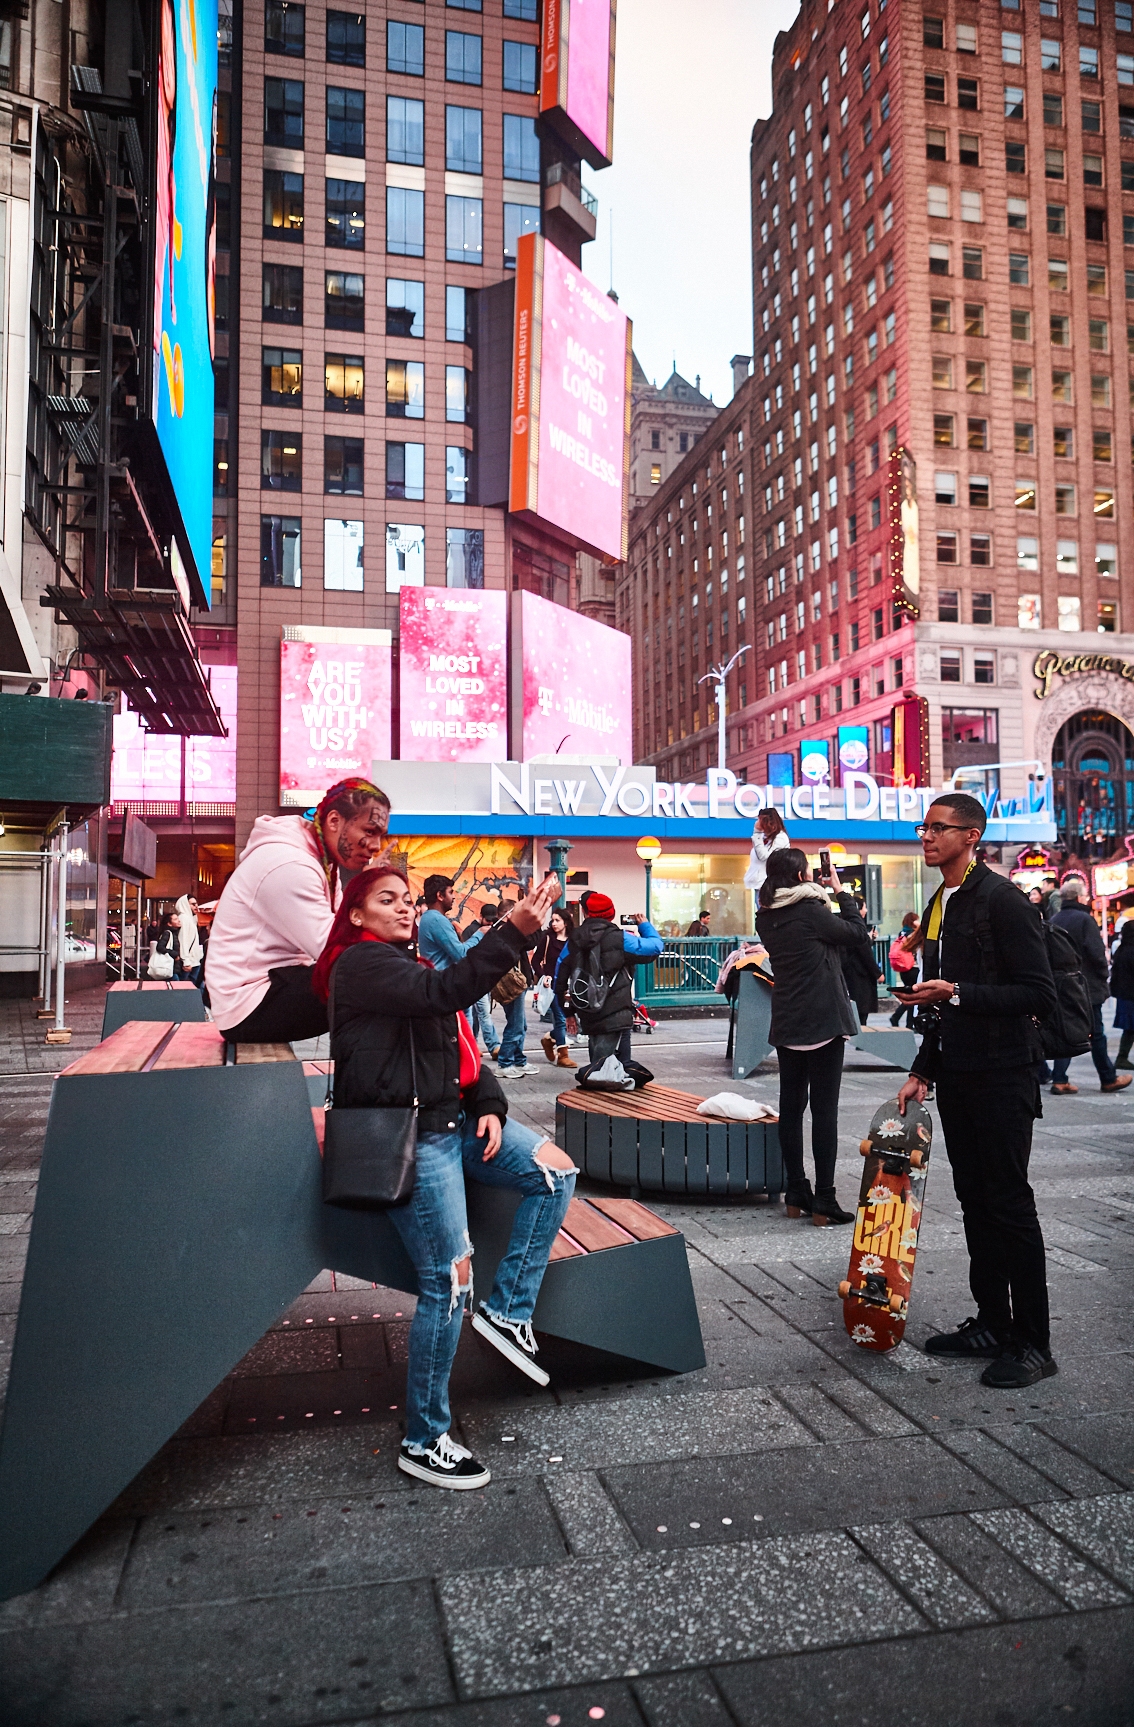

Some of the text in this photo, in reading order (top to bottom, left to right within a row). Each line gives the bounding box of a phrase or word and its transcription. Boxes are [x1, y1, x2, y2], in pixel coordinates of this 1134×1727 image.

[547, 1, 556, 49] THOMSON
[517, 309, 529, 410] THOMSON REUTERS
[566, 336, 606, 385] MOST
[562, 366, 608, 417] LOVED
[577, 409, 593, 440] IN
[308, 661, 361, 685] ARE
[429, 656, 480, 674] MOST
[307, 682, 362, 707] YOU
[425, 677, 484, 695] LOVED
[302, 705, 367, 729] WITH
[446, 700, 464, 716] IN
[309, 728, 358, 751] US?
[410, 720, 498, 739] WIRELESS
[854, 1188, 916, 1263] GIRL
